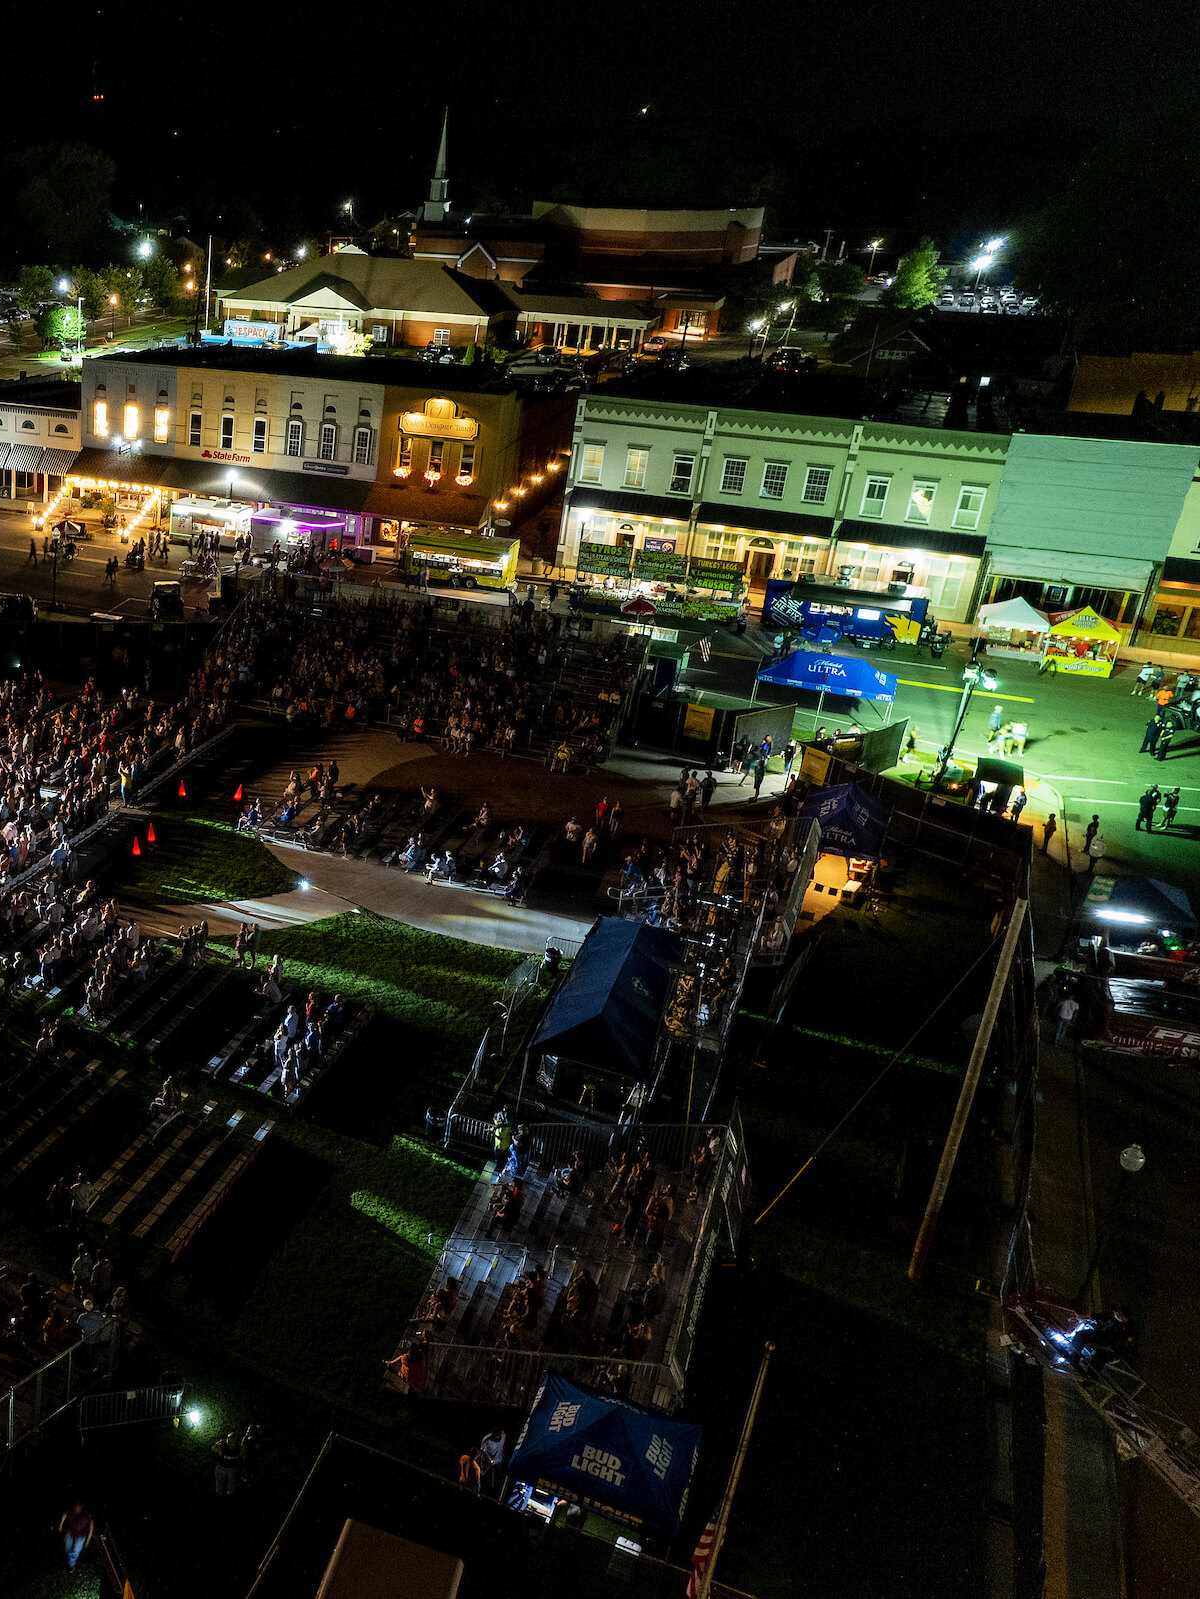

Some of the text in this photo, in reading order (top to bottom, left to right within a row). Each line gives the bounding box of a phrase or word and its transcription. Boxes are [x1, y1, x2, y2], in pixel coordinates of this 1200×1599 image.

[591, 544, 623, 556] GYROS
[808, 664, 847, 678] ULTRA
[548, 1401, 572, 1433] LIGHT
[562, 1403, 582, 1428] BUD
[581, 1444, 622, 1471] BUD
[645, 1433, 661, 1464] BUD
[652, 1437, 674, 1481] LIGHT
[570, 1454, 626, 1488] LIGHT
